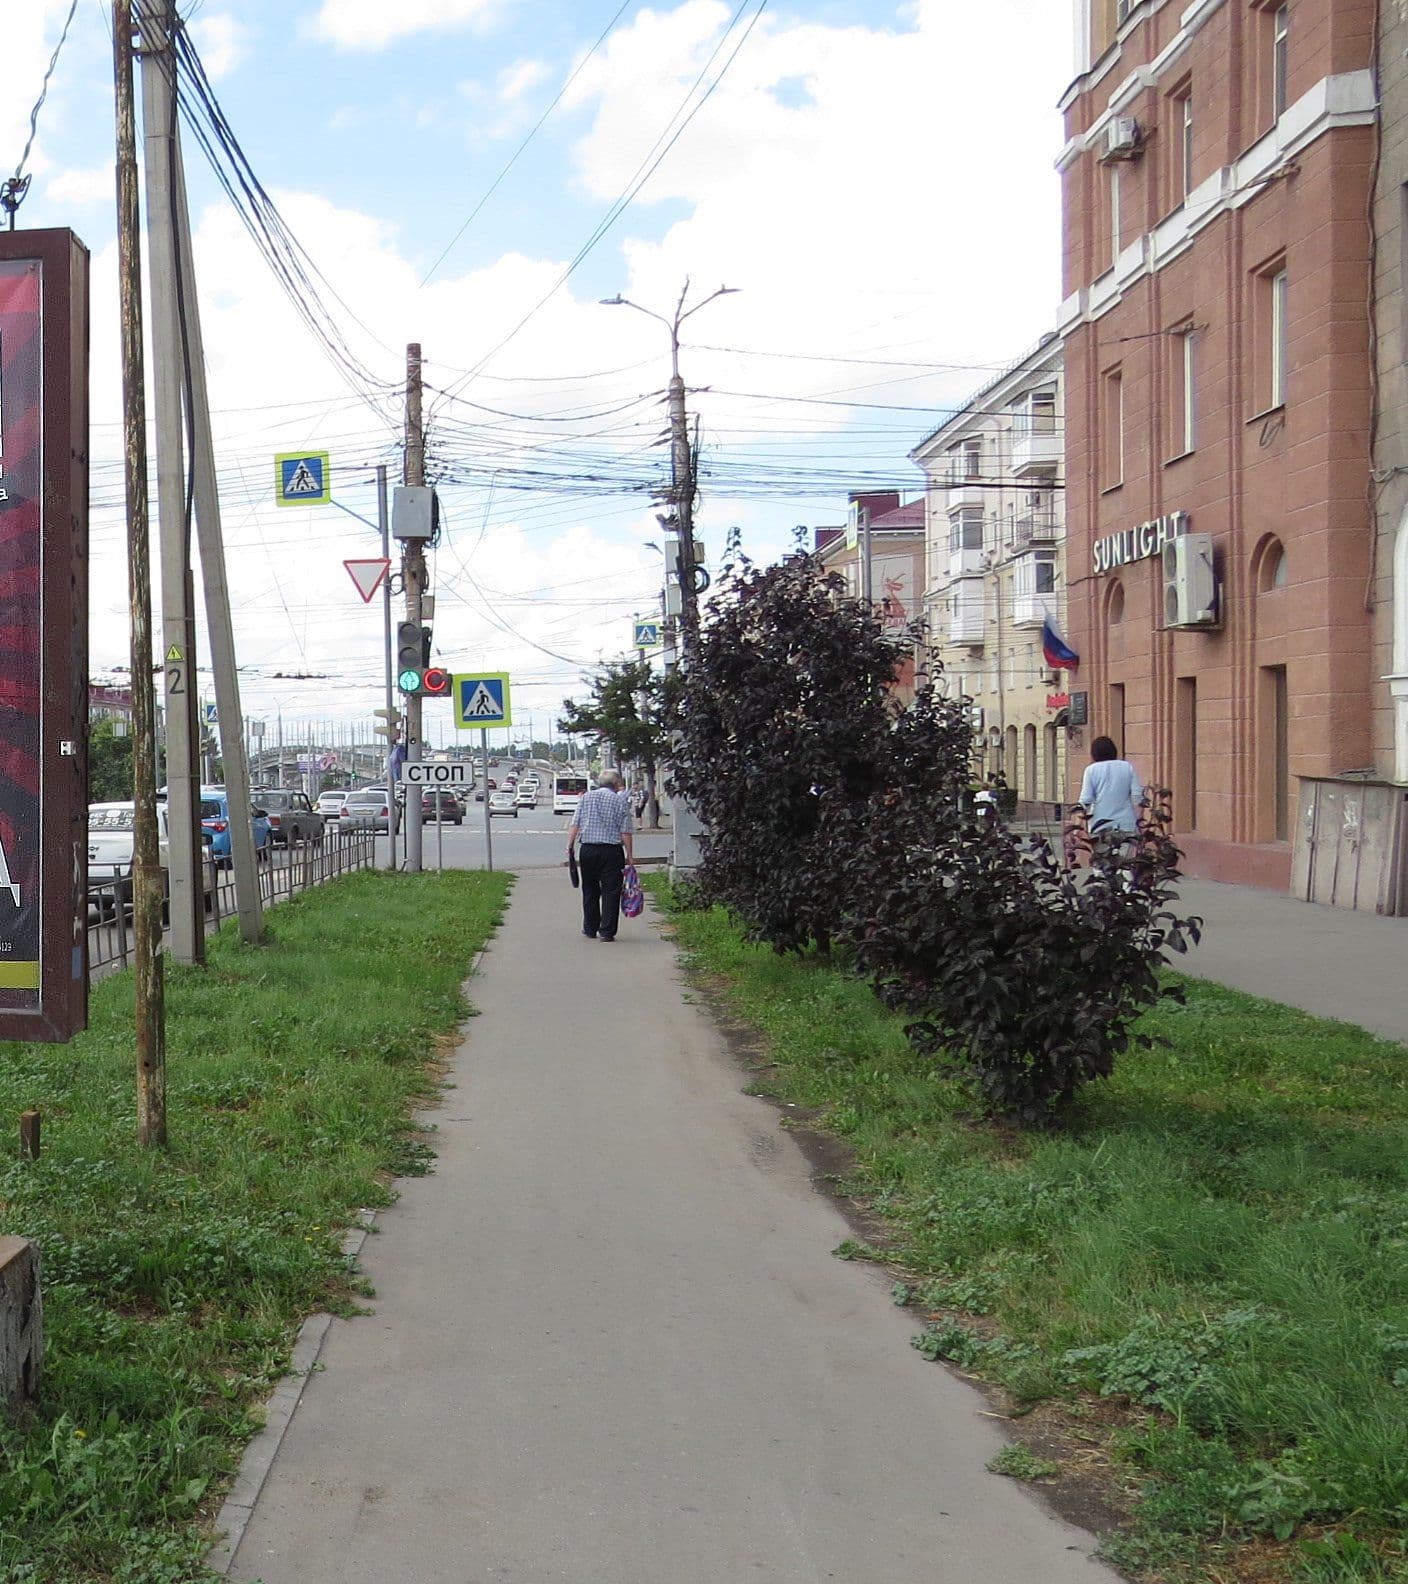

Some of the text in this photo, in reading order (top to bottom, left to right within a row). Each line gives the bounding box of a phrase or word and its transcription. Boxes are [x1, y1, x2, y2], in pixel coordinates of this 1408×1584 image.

[1093, 510, 1184, 573] SUNLIGHT
[167, 668, 185, 695] 2
[408, 766, 464, 782] СТОП
